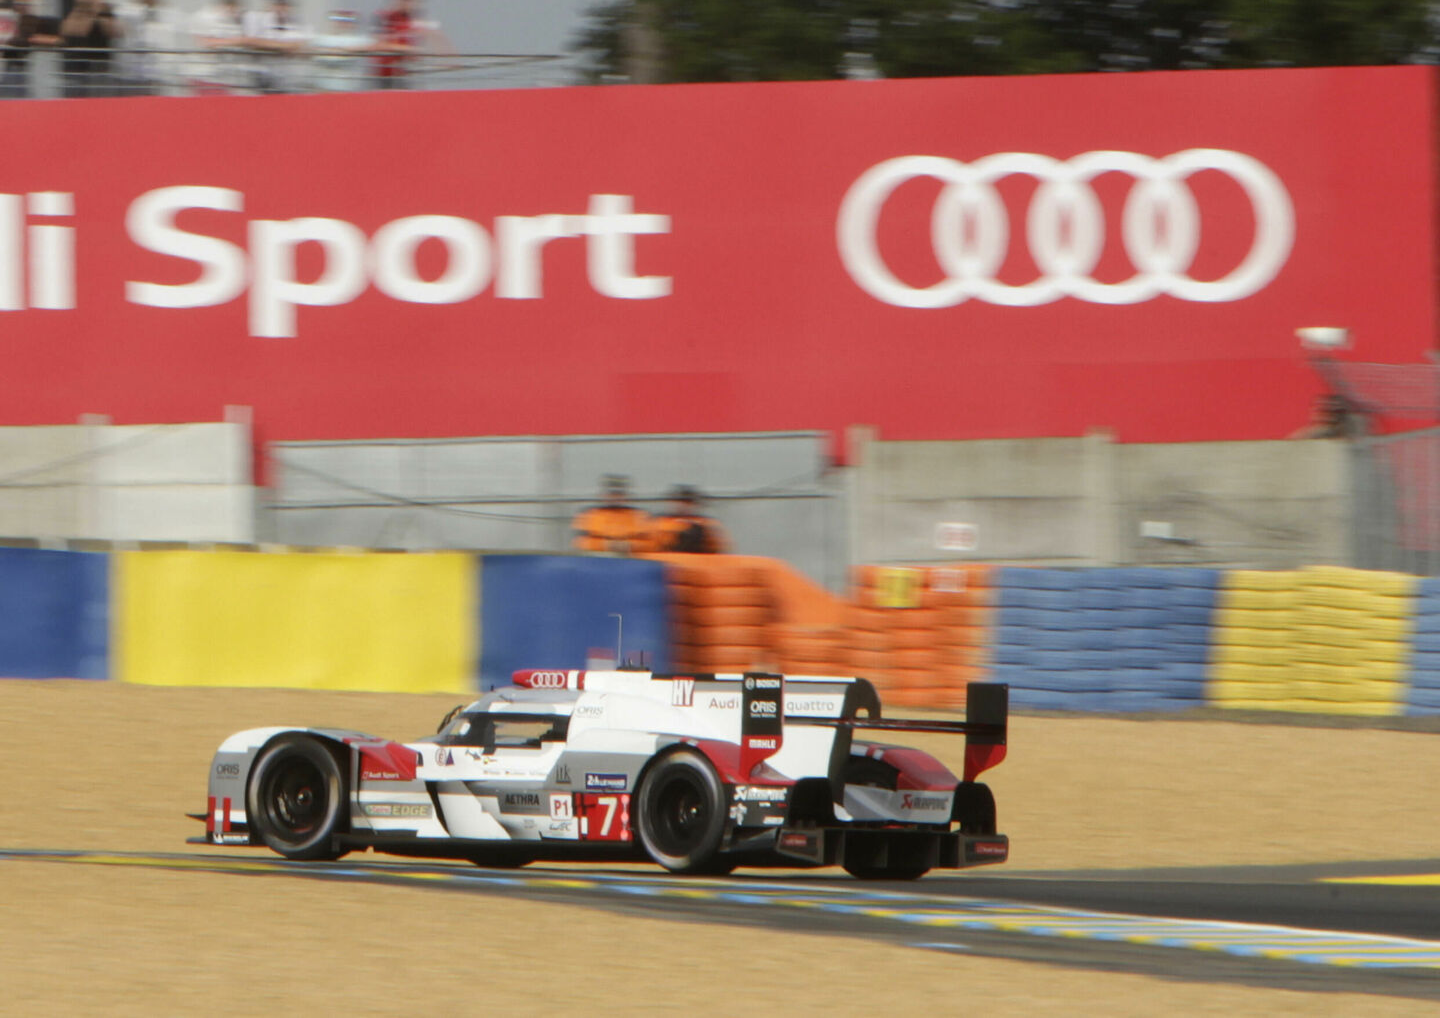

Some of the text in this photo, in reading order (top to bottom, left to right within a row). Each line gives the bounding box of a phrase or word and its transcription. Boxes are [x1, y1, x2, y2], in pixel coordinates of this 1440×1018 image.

[124, 185, 673, 337] Sport
[709, 697, 835, 712] Audi quattro
[750, 700, 777, 713] ORIS
[216, 764, 240, 775] ORIS
[505, 793, 540, 806] AETHRA
[392, 805, 428, 816] EDGE
[553, 799, 569, 817] P1
[598, 797, 618, 836] 7
